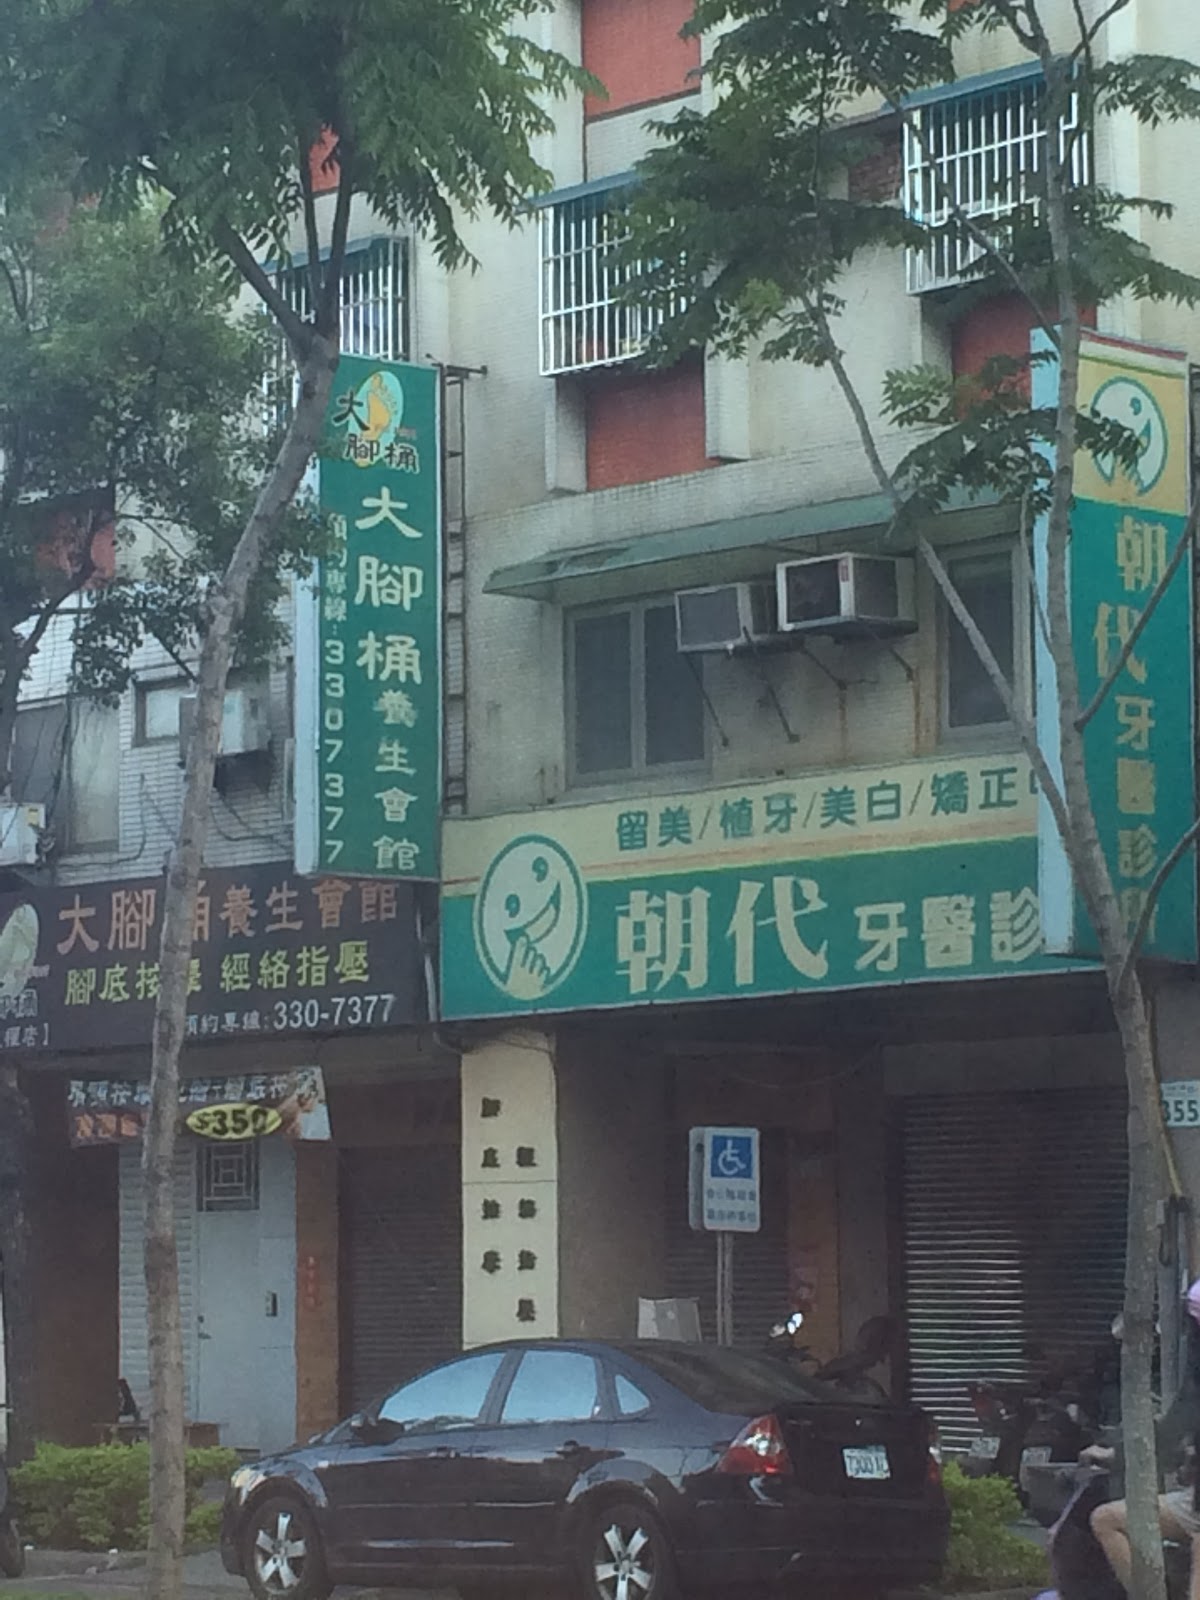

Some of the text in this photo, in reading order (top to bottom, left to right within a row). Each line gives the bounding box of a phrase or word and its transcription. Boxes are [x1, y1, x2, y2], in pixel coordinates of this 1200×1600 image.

[354, 485, 424, 871] 大腳桶養生會館
[617, 766, 1038, 851] 留美/植牙/美白/矯正
[220, 940, 370, 992] 經絡指壓
